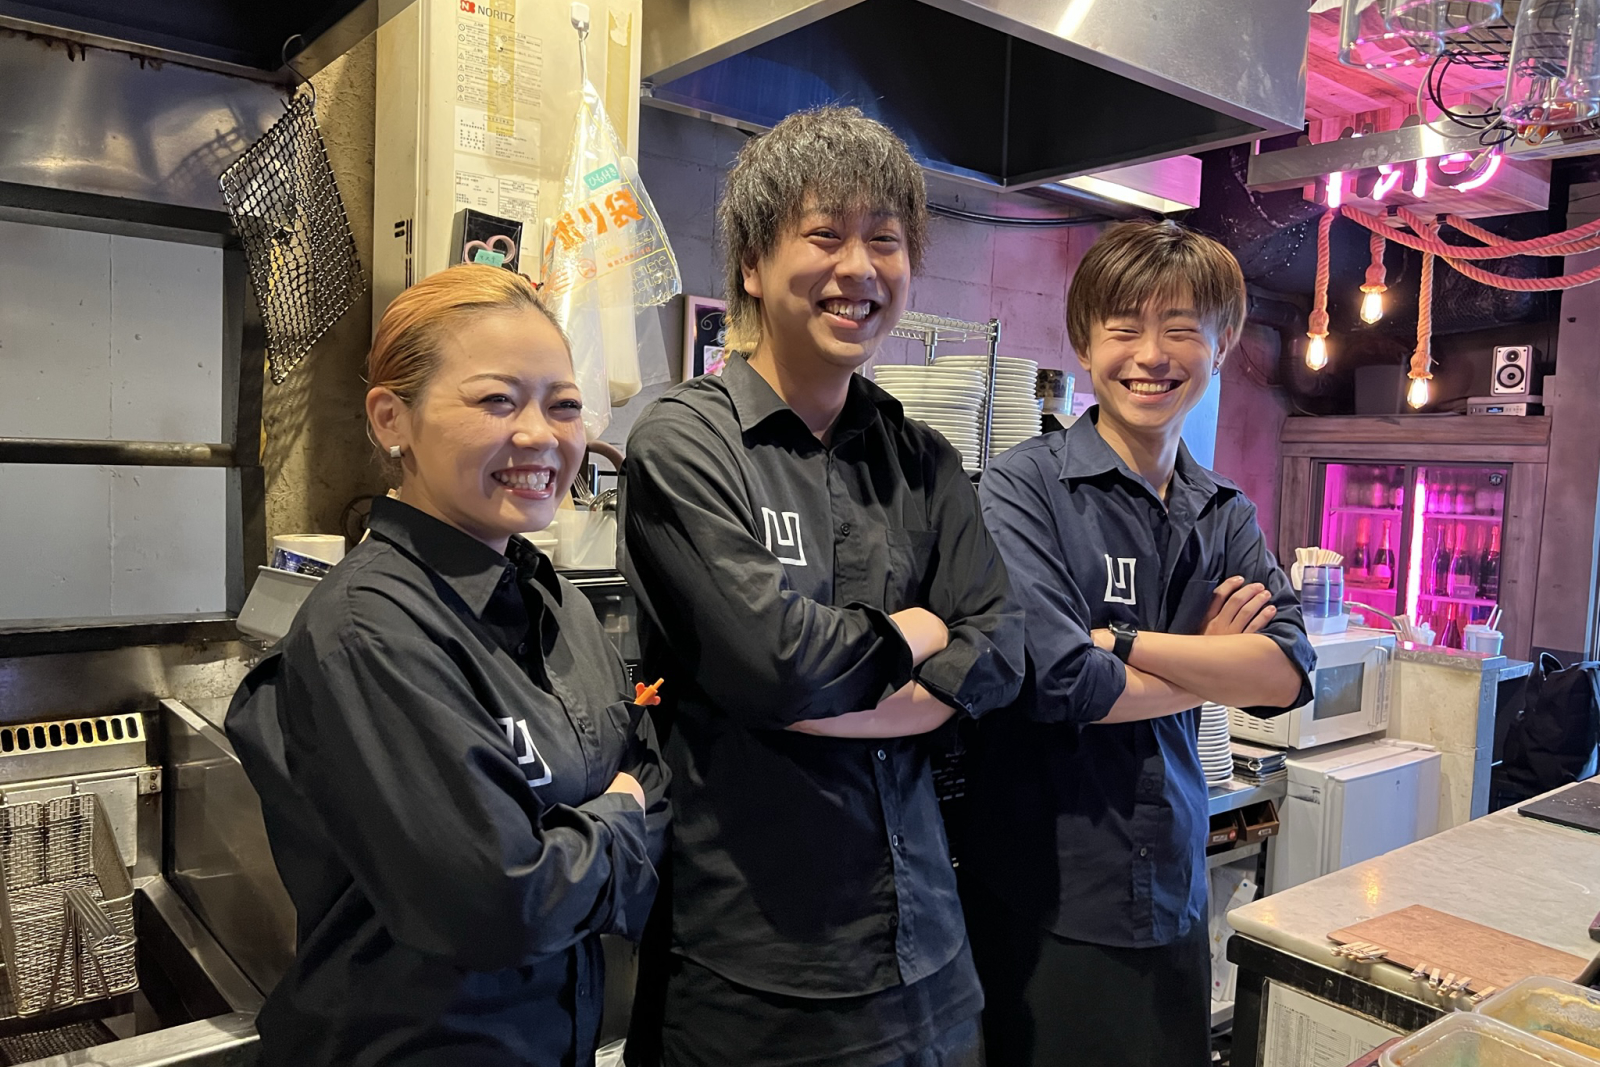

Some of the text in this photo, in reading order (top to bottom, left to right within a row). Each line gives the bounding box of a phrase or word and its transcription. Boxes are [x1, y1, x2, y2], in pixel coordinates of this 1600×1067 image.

[477, 5, 515, 24] NORITZ
[588, 166, 617, 187] ひも付き
